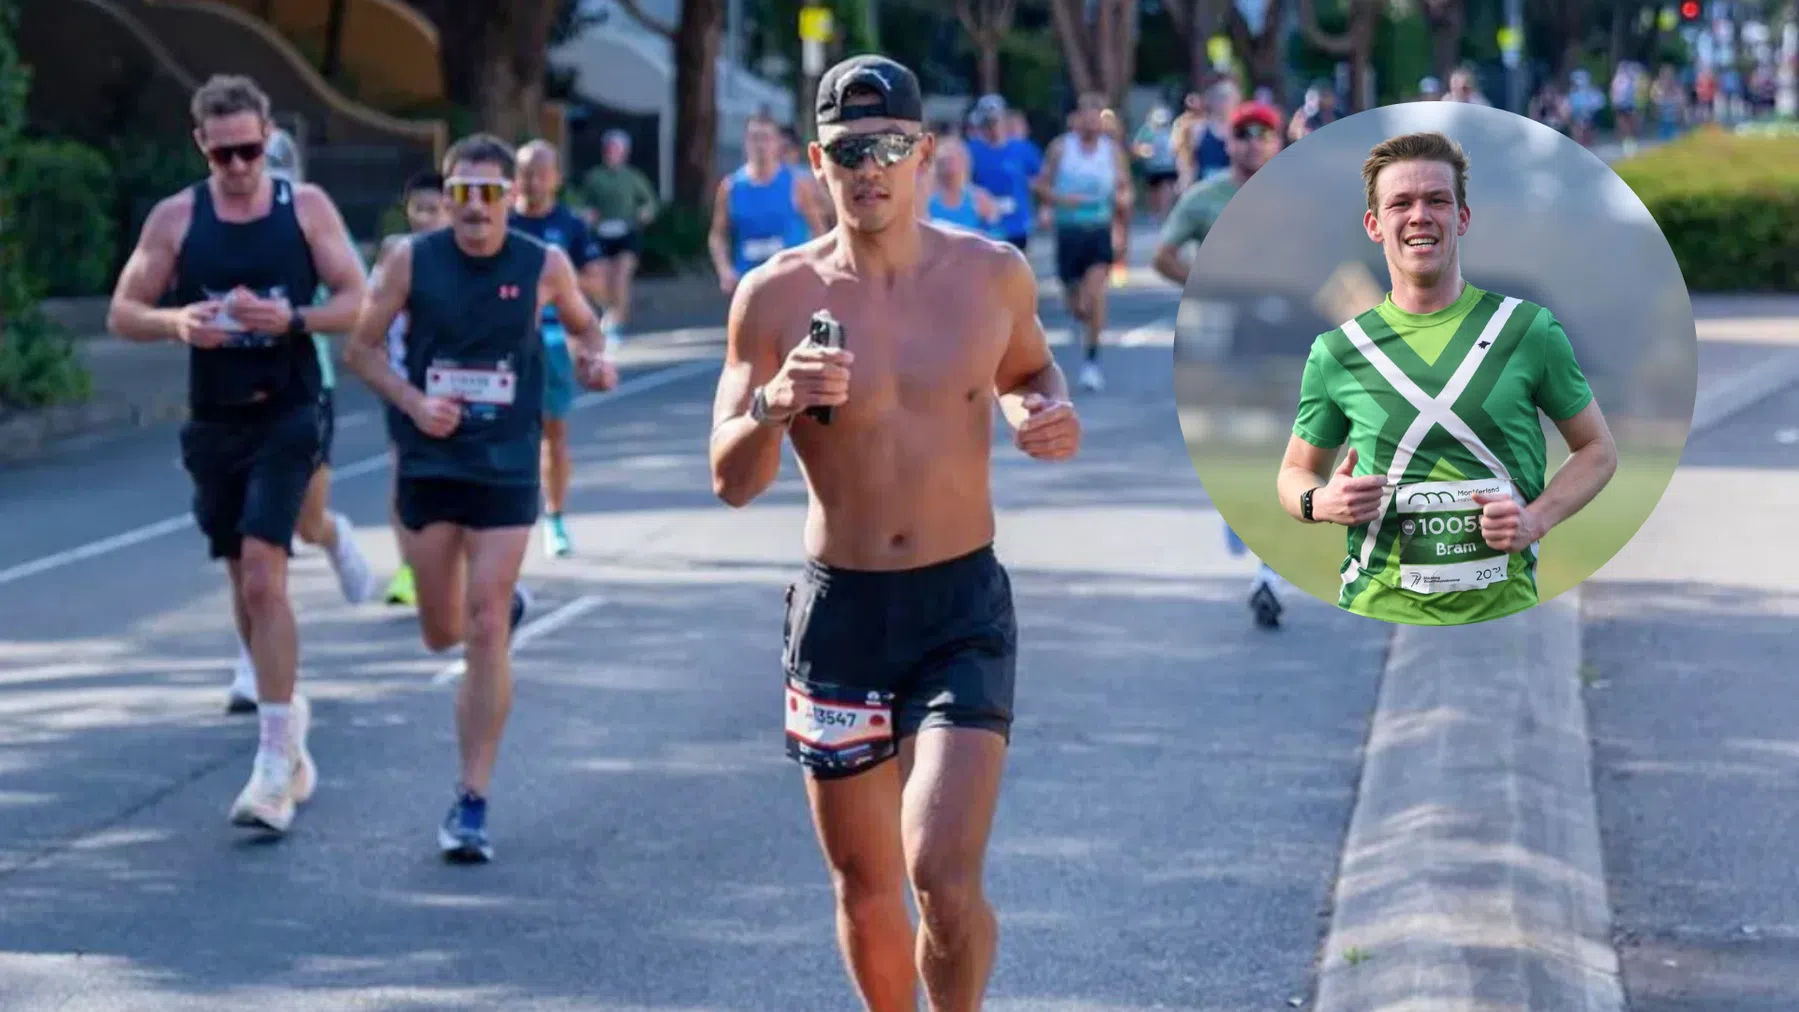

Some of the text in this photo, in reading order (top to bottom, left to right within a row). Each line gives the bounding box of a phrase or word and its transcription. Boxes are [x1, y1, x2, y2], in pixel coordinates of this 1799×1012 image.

[1418, 515, 1483, 535] 1005
[1436, 542, 1476, 556] Bram
[1476, 567, 1503, 581] 20
